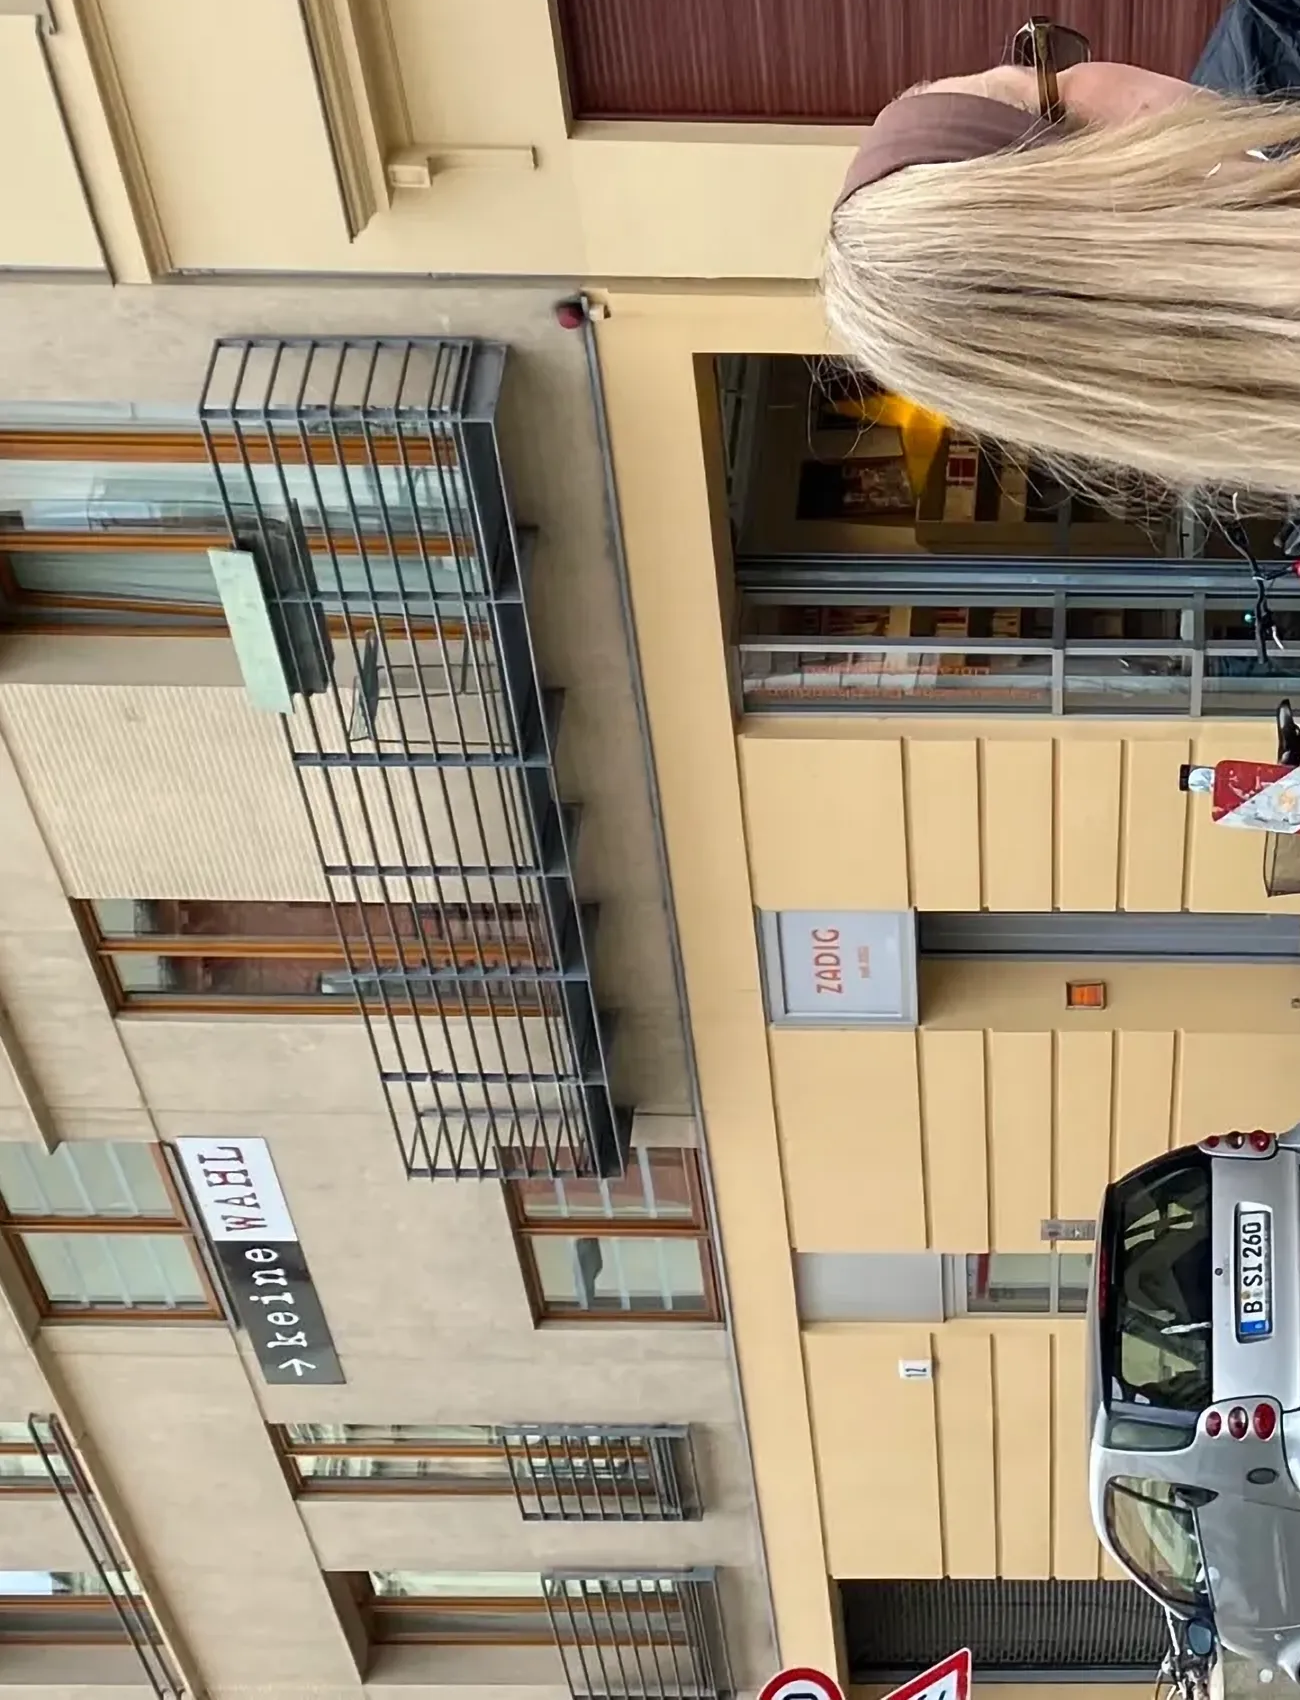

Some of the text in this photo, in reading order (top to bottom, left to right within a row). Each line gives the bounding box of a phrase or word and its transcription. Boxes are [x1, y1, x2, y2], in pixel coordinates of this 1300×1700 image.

[811, 928, 843, 995] ZADIG
[197, 1146, 308, 1348] keine WAHL
[1241, 1221, 1263, 1314] B SI 260
[904, 1367, 927, 1378] 12
